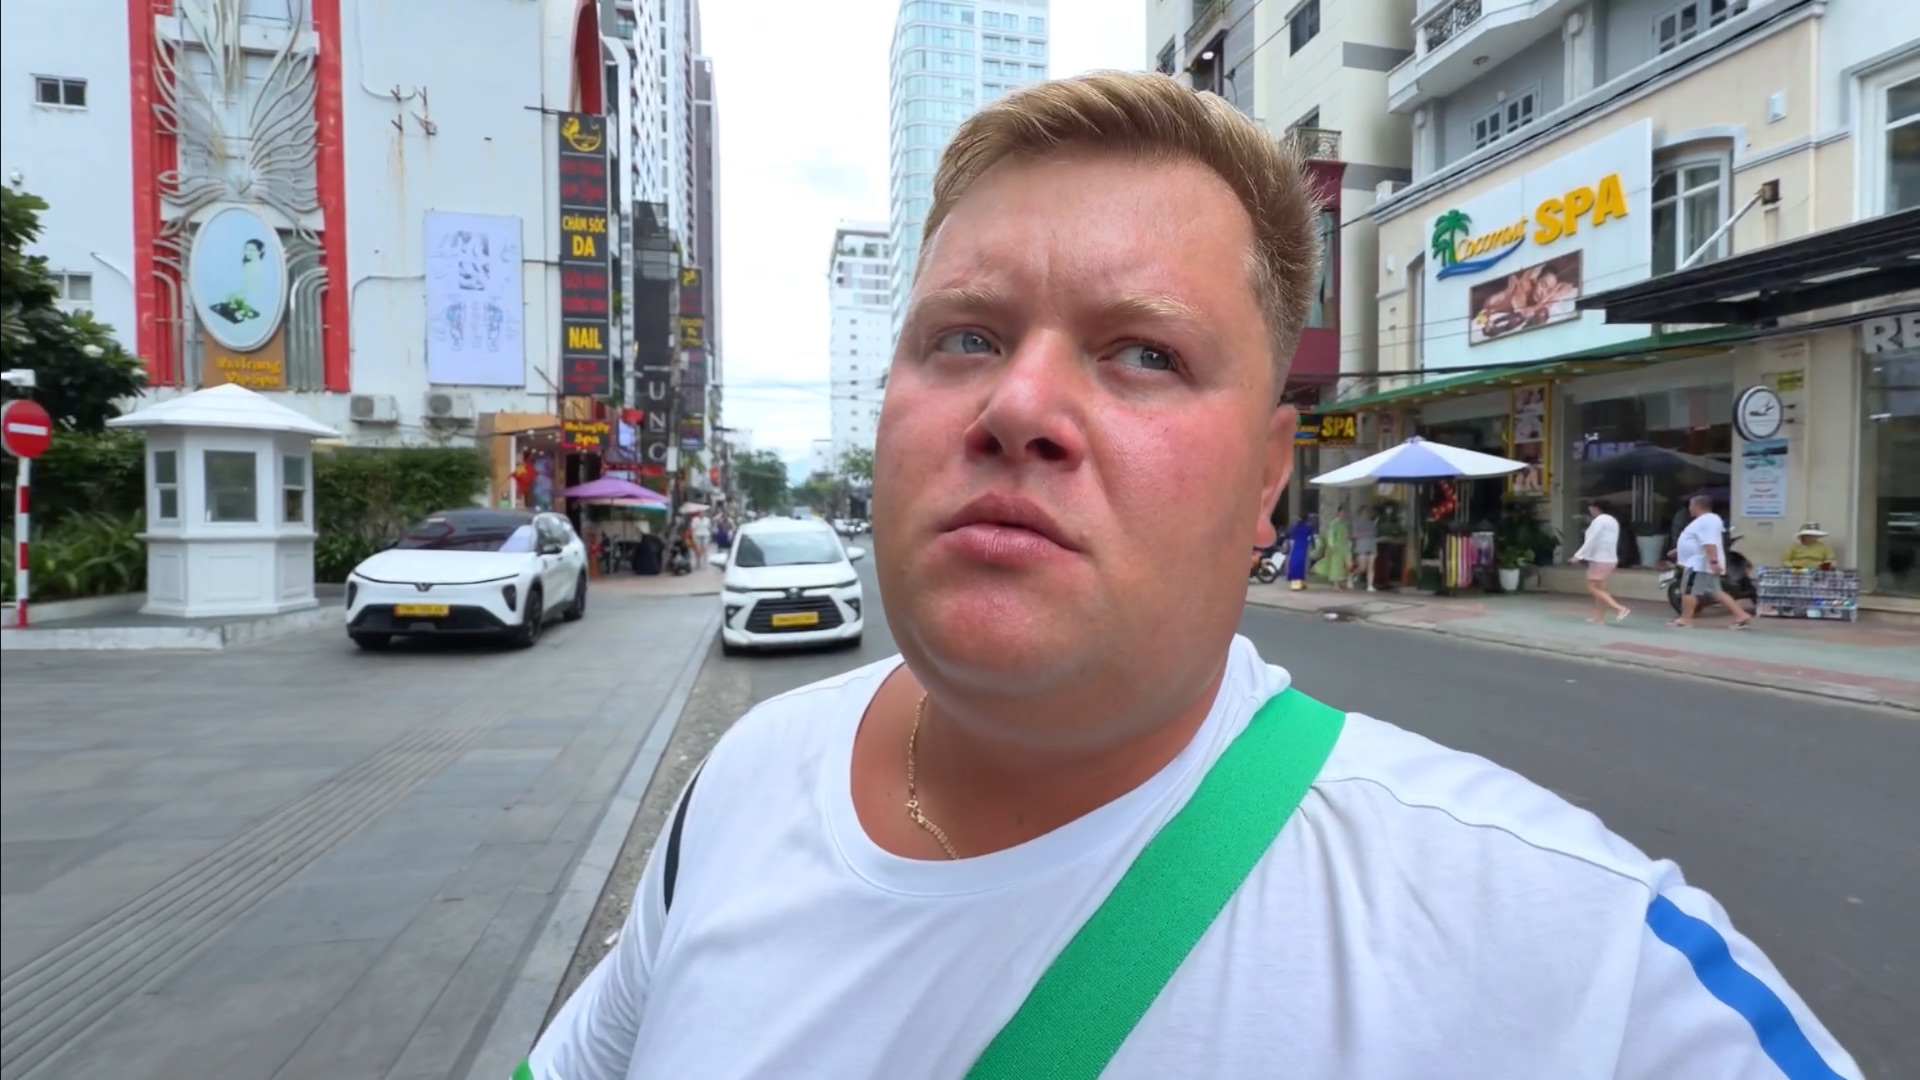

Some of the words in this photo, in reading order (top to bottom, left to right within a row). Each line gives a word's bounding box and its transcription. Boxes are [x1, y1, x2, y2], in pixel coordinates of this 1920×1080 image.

[1456, 216, 1528, 262] Coconut
[1533, 172, 1628, 246] SPA
[572, 234, 596, 257] DA
[568, 326, 602, 350] NAIL
[1321, 415, 1355, 437] SPA
